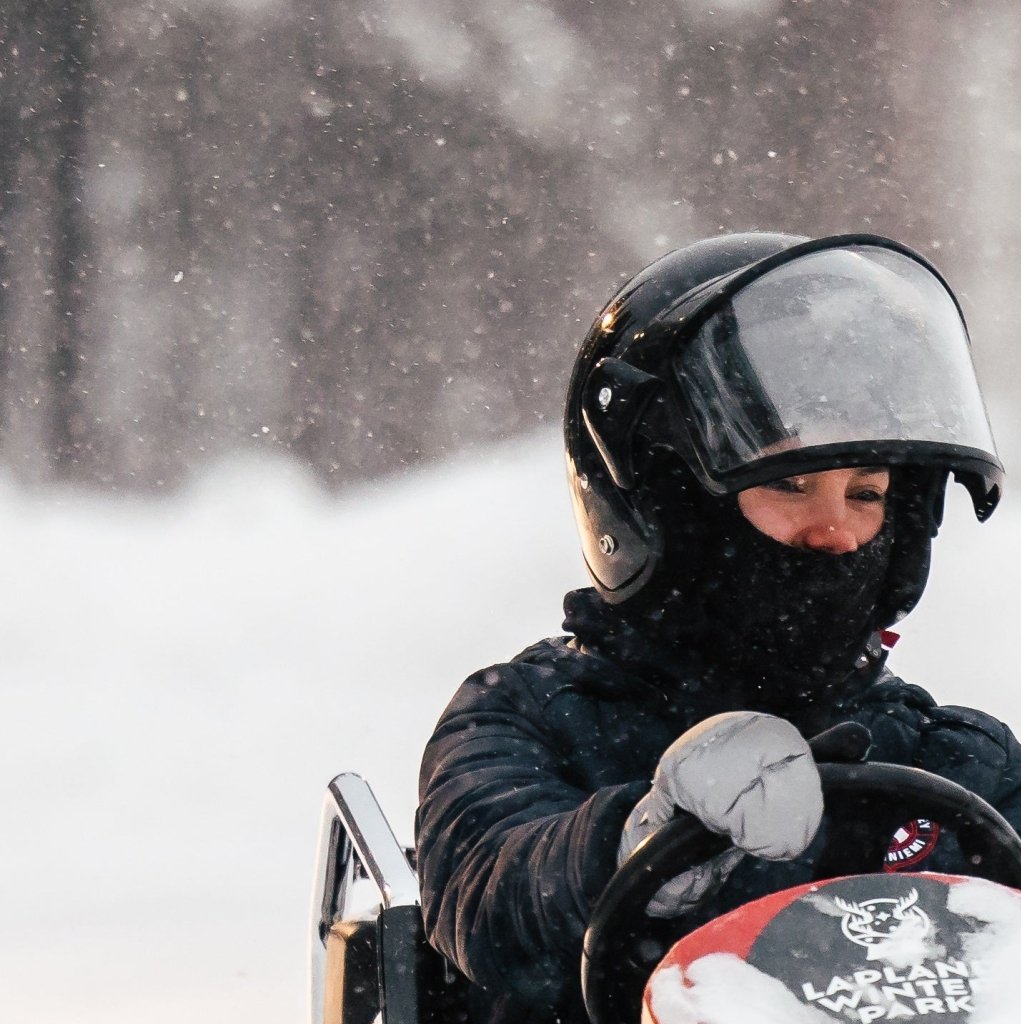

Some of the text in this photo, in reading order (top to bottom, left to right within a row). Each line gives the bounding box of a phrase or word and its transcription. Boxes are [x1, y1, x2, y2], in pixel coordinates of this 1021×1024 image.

[884, 839, 926, 862] NIEMI
[802, 958, 975, 1001] LAPLAN
[817, 978, 974, 1013] WINTE
[858, 996, 975, 1024] PARK
